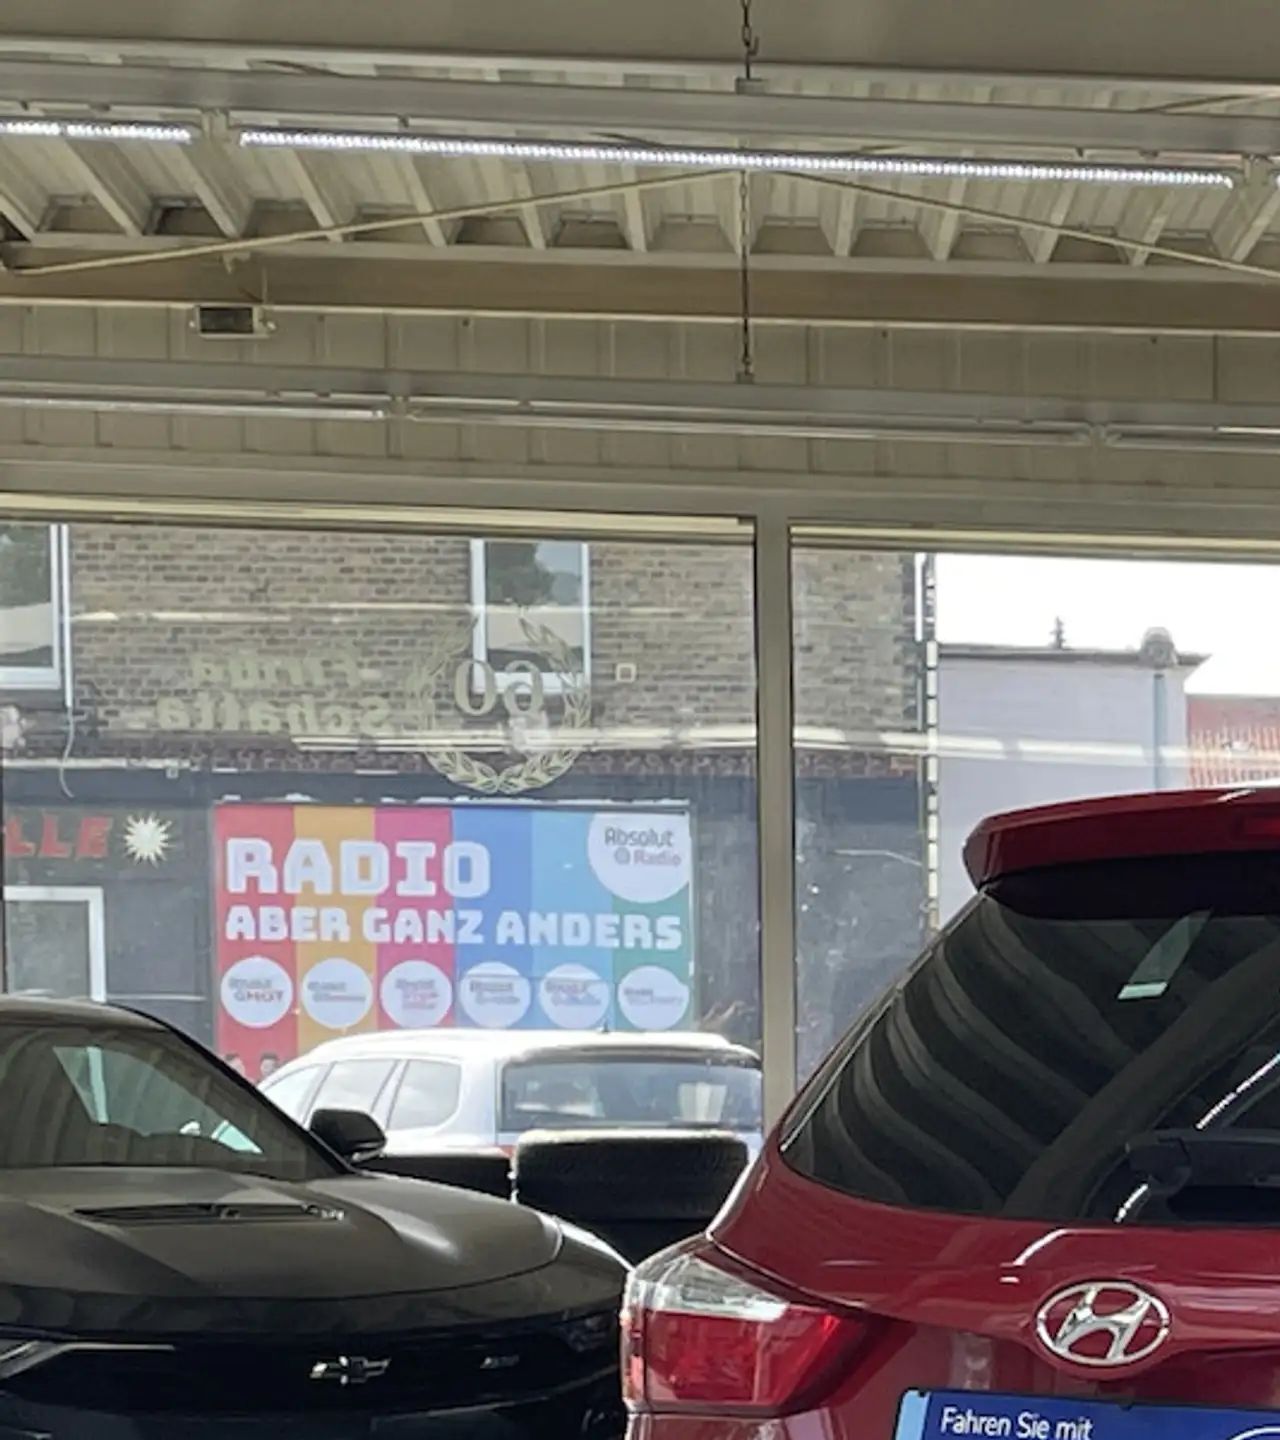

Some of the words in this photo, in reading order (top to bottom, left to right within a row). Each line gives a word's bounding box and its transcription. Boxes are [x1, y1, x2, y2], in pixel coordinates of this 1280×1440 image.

[604, 828, 675, 848] Absolut
[226, 837, 491, 898] RADIO
[225, 905, 351, 942] ABER
[362, 907, 485, 945] GANZ
[496, 911, 683, 950] ANDERS
[941, 1406, 1011, 1437] Fahren
[1016, 1411, 1050, 1440] Sie
